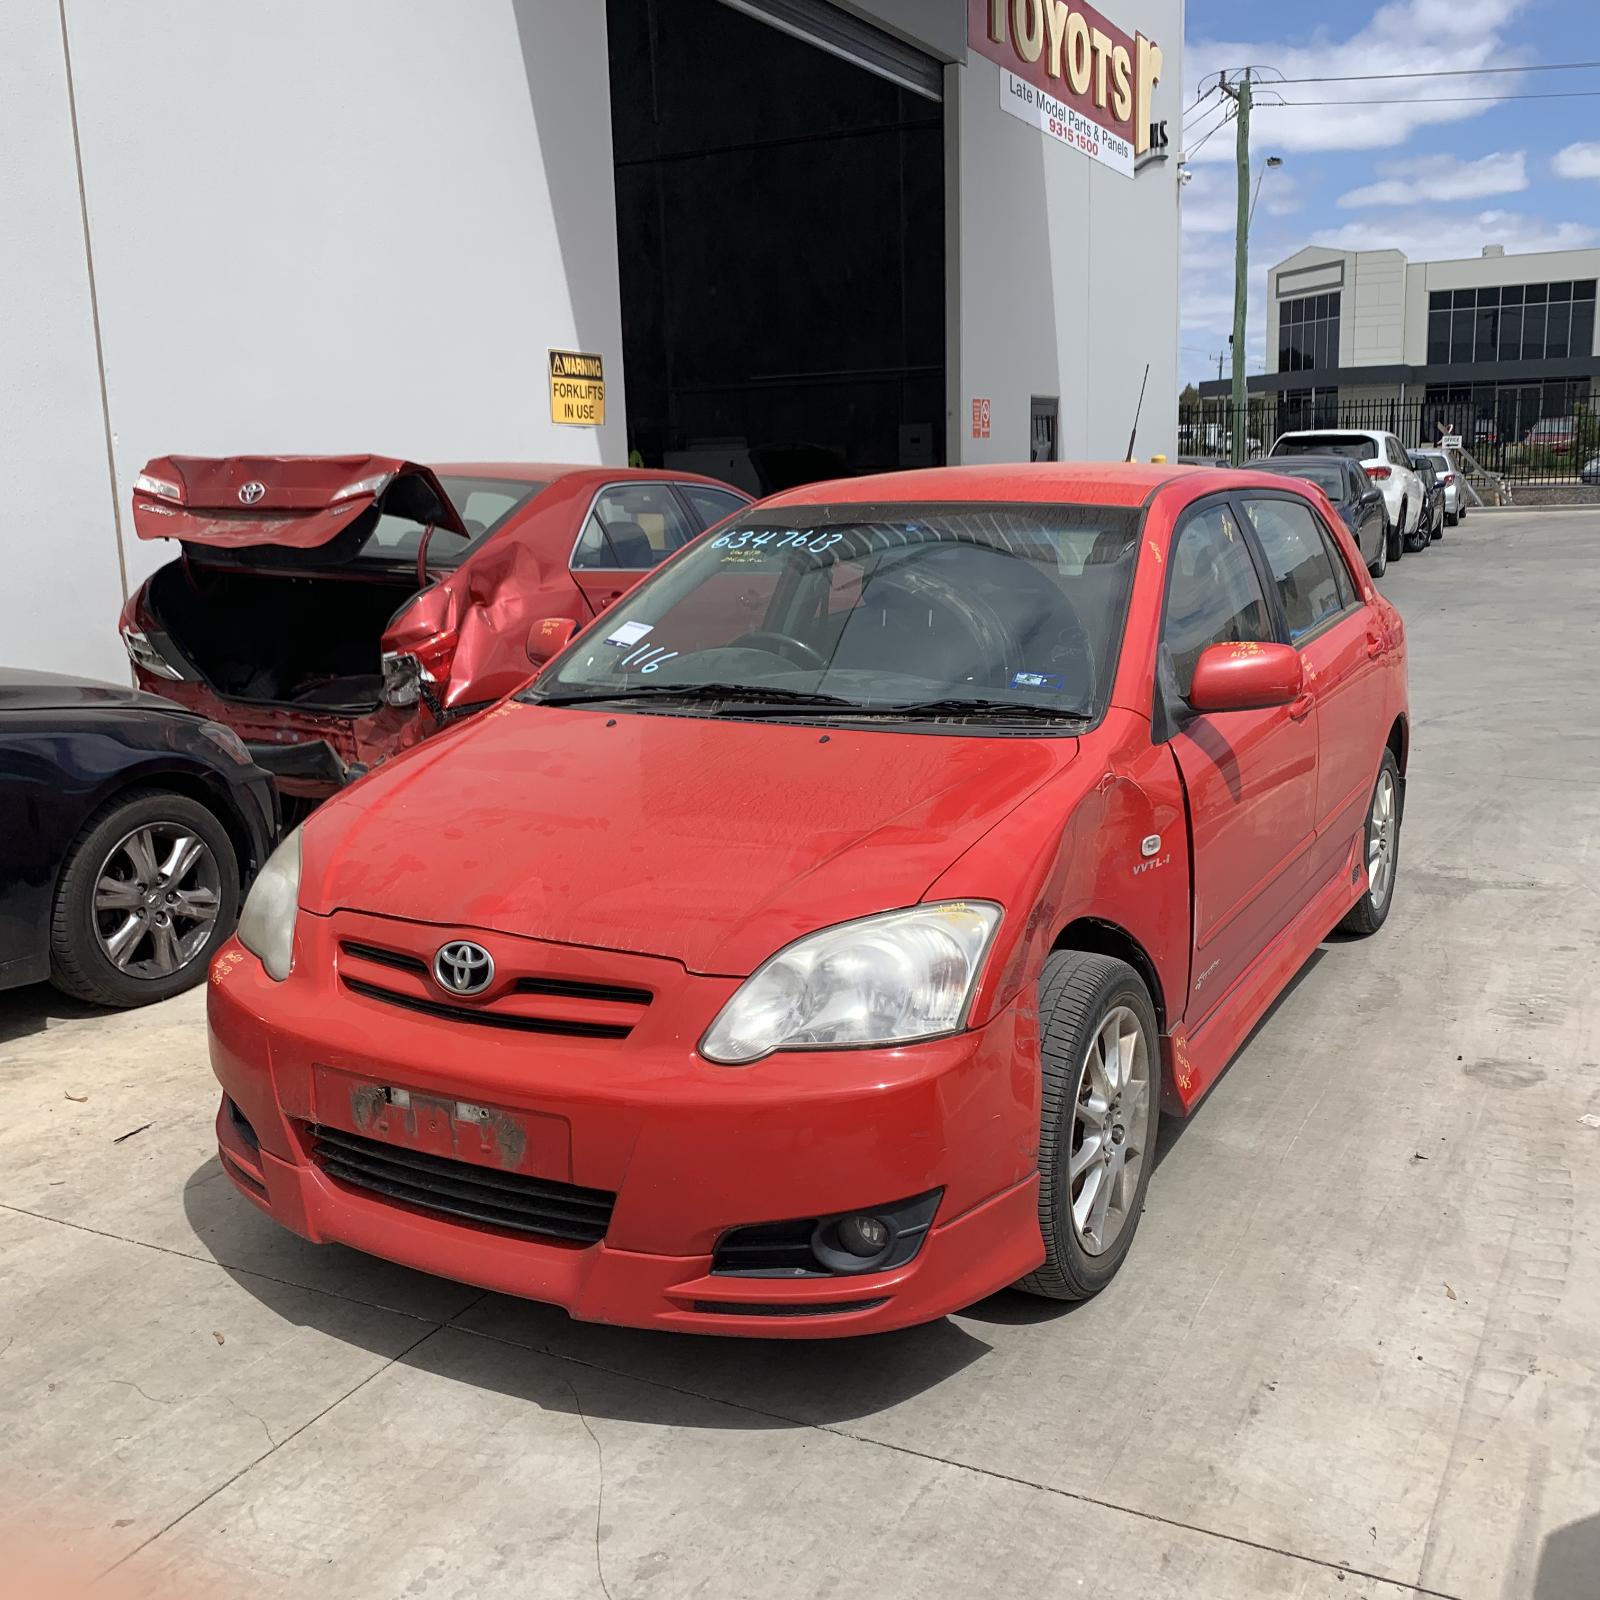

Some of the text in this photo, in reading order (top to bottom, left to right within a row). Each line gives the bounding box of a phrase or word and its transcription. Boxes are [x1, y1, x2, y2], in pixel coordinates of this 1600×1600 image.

[1009, 74, 1129, 159] Late Model Parts & Panels
[1049, 118, 1099, 156] 9315 1500
[562, 356, 601, 377] WARNING
[553, 382, 604, 401] FORKLIFTS
[564, 403, 595, 420] IN USE
